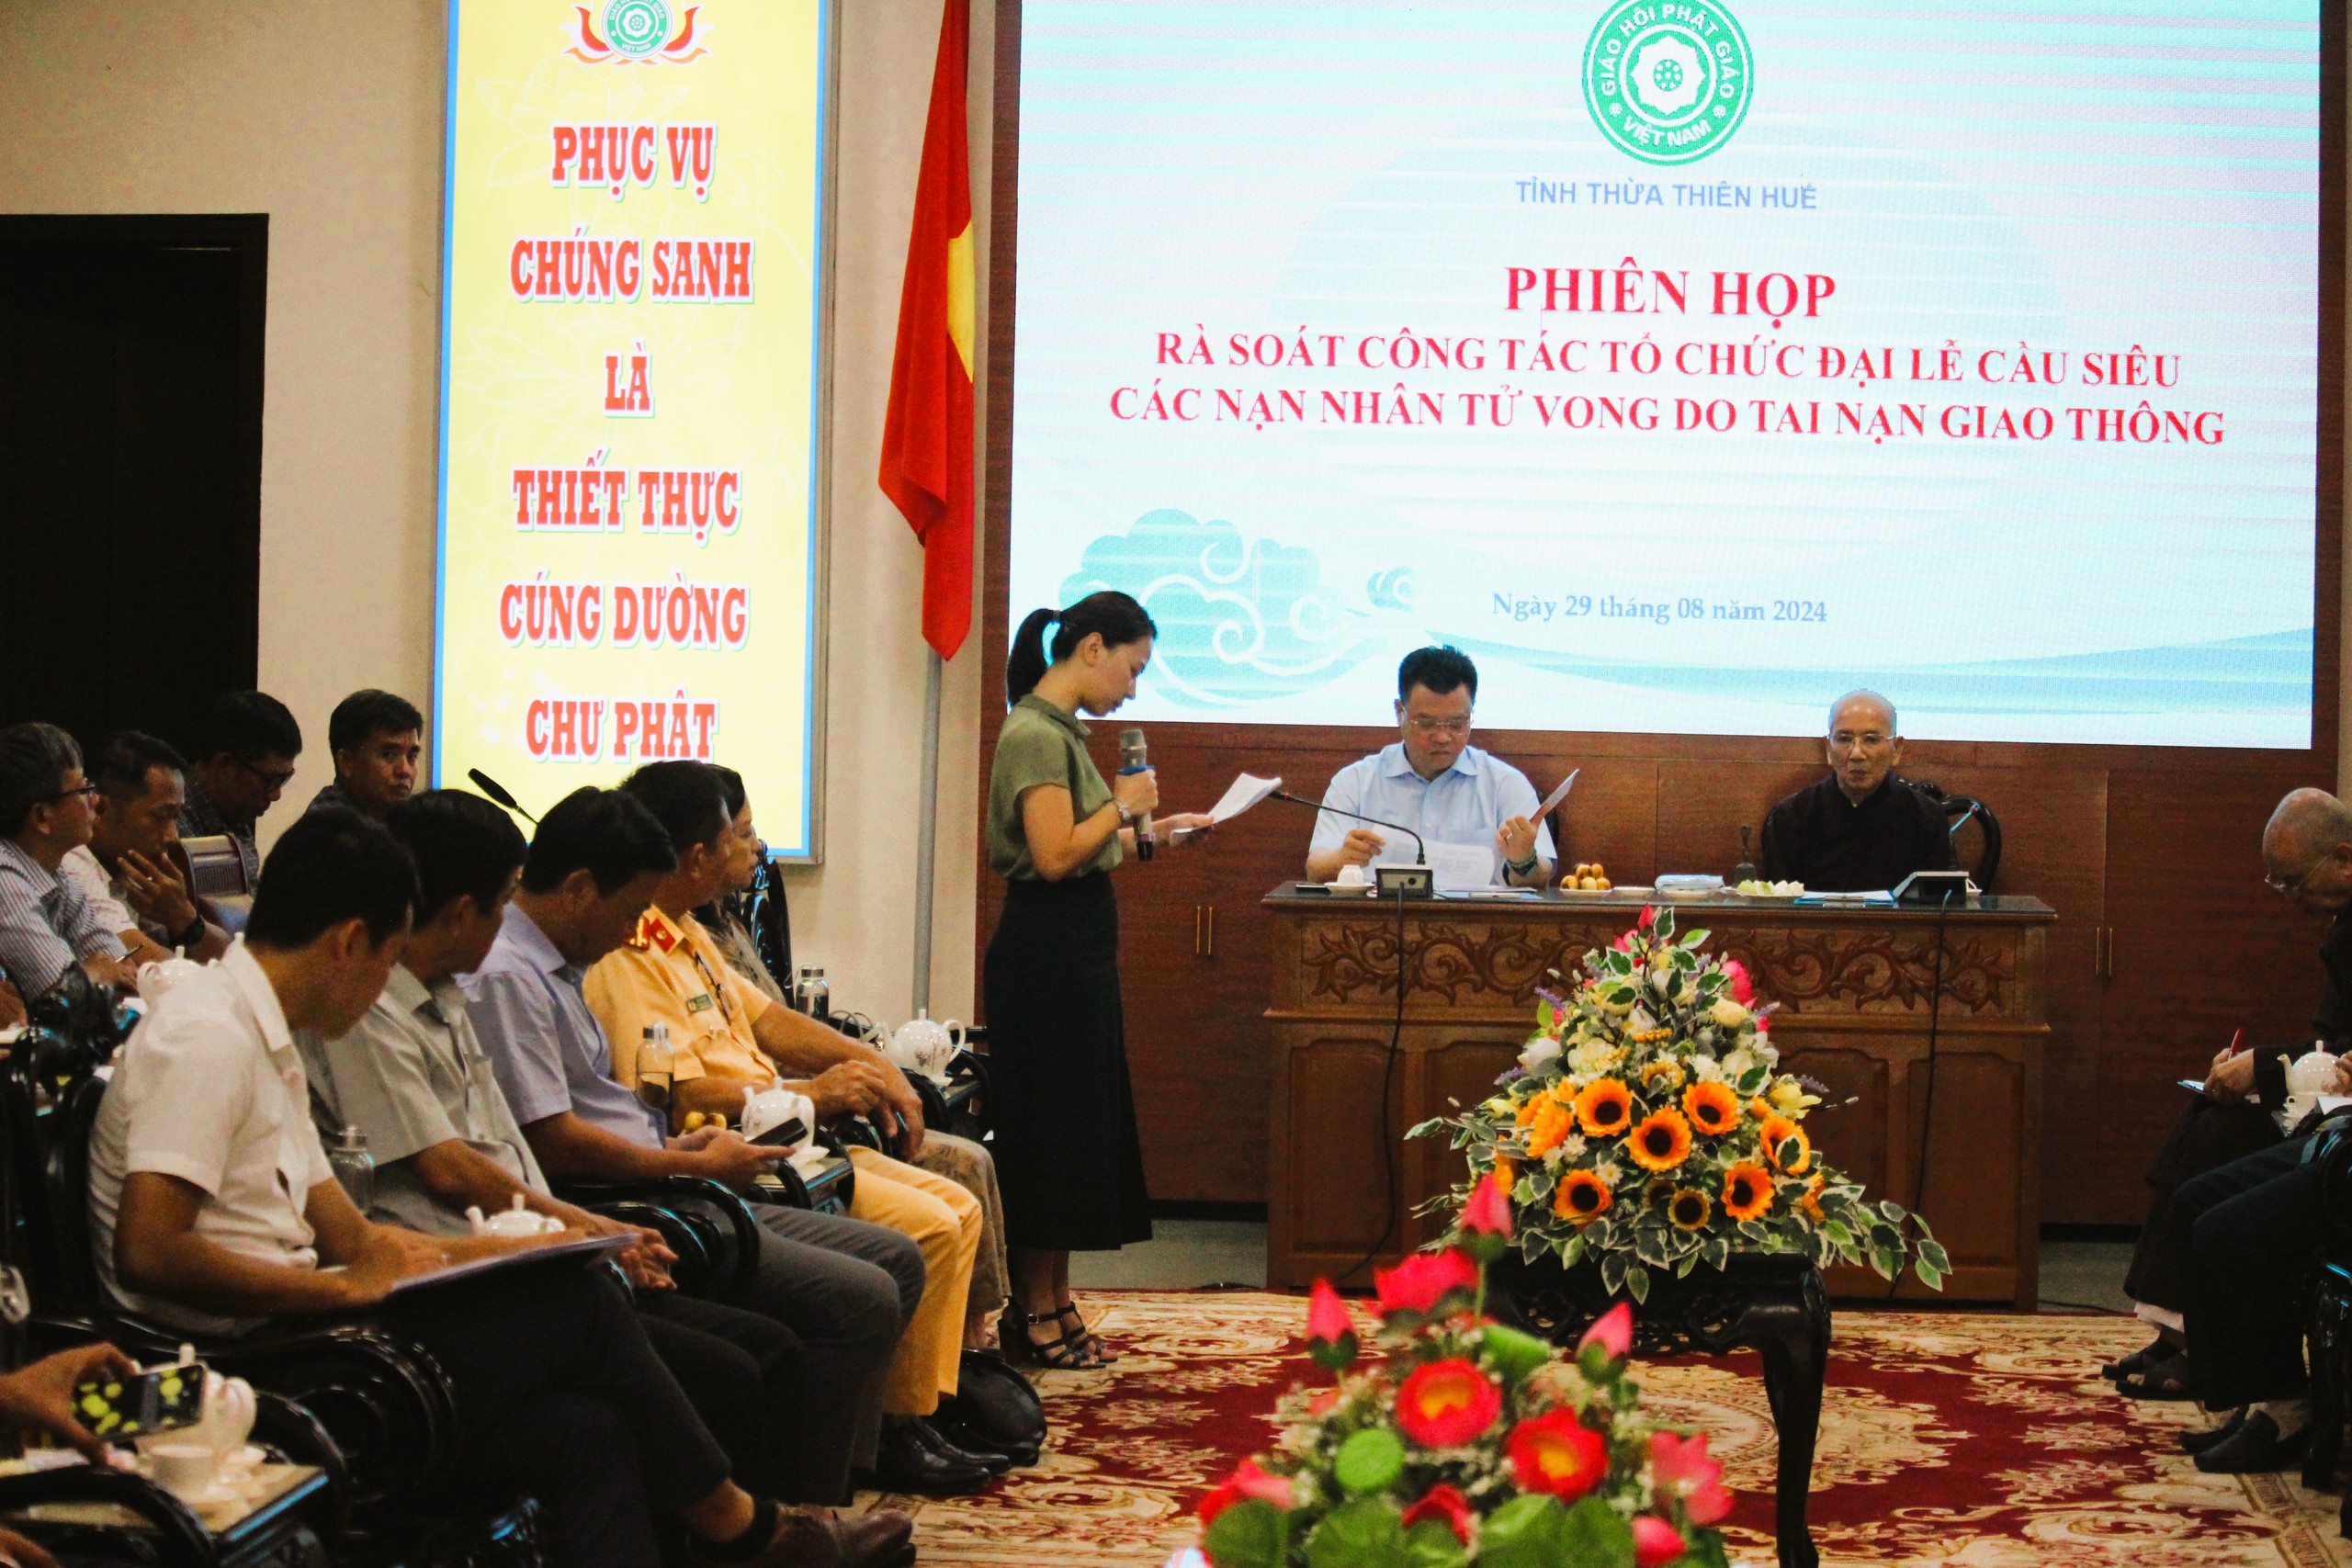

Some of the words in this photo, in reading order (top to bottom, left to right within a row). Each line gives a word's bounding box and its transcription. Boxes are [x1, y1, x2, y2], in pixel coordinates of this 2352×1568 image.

[1599, 39, 1622, 96] GIÁO
[1619, 6, 1656, 37] HỘI
[1662, 4, 1719, 37] PHẬT
[1715, 40, 1740, 98] GIÁO
[553, 126, 653, 195] PHỤC
[667, 128, 713, 196] VỤ
[1623, 116, 1665, 146] VIỆT
[1667, 119, 1713, 147] NAM
[1516, 176, 1577, 204] TỈNH
[1587, 177, 1664, 207] THỪA
[1671, 181, 1751, 208] THIÊN
[511, 229, 639, 296] CHÚNG
[653, 242, 751, 297] SANH
[1508, 256, 1688, 313] PHIÊN
[1713, 272, 1836, 329] HỌP
[605, 344, 650, 410] LÀ
[1158, 323, 1214, 365] RÀ
[1229, 325, 1344, 367] SOÁT
[1358, 327, 1484, 369] CÔNG
[1499, 330, 1587, 371] TÁC
[1601, 334, 1661, 373] TỔ
[1676, 334, 1804, 377] CHỨC
[1820, 347, 1892, 388] ĐẠI
[1912, 340, 1962, 380] LỄ
[1978, 342, 2066, 384] CẦU
[2083, 344, 2178, 387] SIÊU
[1111, 378, 1200, 421] CÁC
[1216, 389, 1305, 430] NẠN
[1322, 383, 1443, 424] NHÂN
[1459, 385, 1522, 426] TỬ
[1534, 396, 1658, 430] VONG
[1676, 399, 1736, 431] DO
[1750, 400, 1819, 434] TAI
[1837, 402, 1925, 444] NẠN
[1941, 406, 2053, 439] GIAO
[2066, 400, 2222, 444] THÔNG
[514, 451, 625, 525] THIẾT
[639, 472, 737, 540] THỰC
[501, 573, 599, 640] CÚNG
[614, 574, 745, 642] DƯỜNG
[1492, 592, 1555, 622] Ngày
[1565, 595, 1592, 616] 29
[1600, 595, 1671, 625] tháng
[1677, 597, 1705, 619] 08
[1712, 600, 1765, 621] năm
[1772, 600, 1827, 622] 2024
[527, 700, 603, 755] CHƯ
